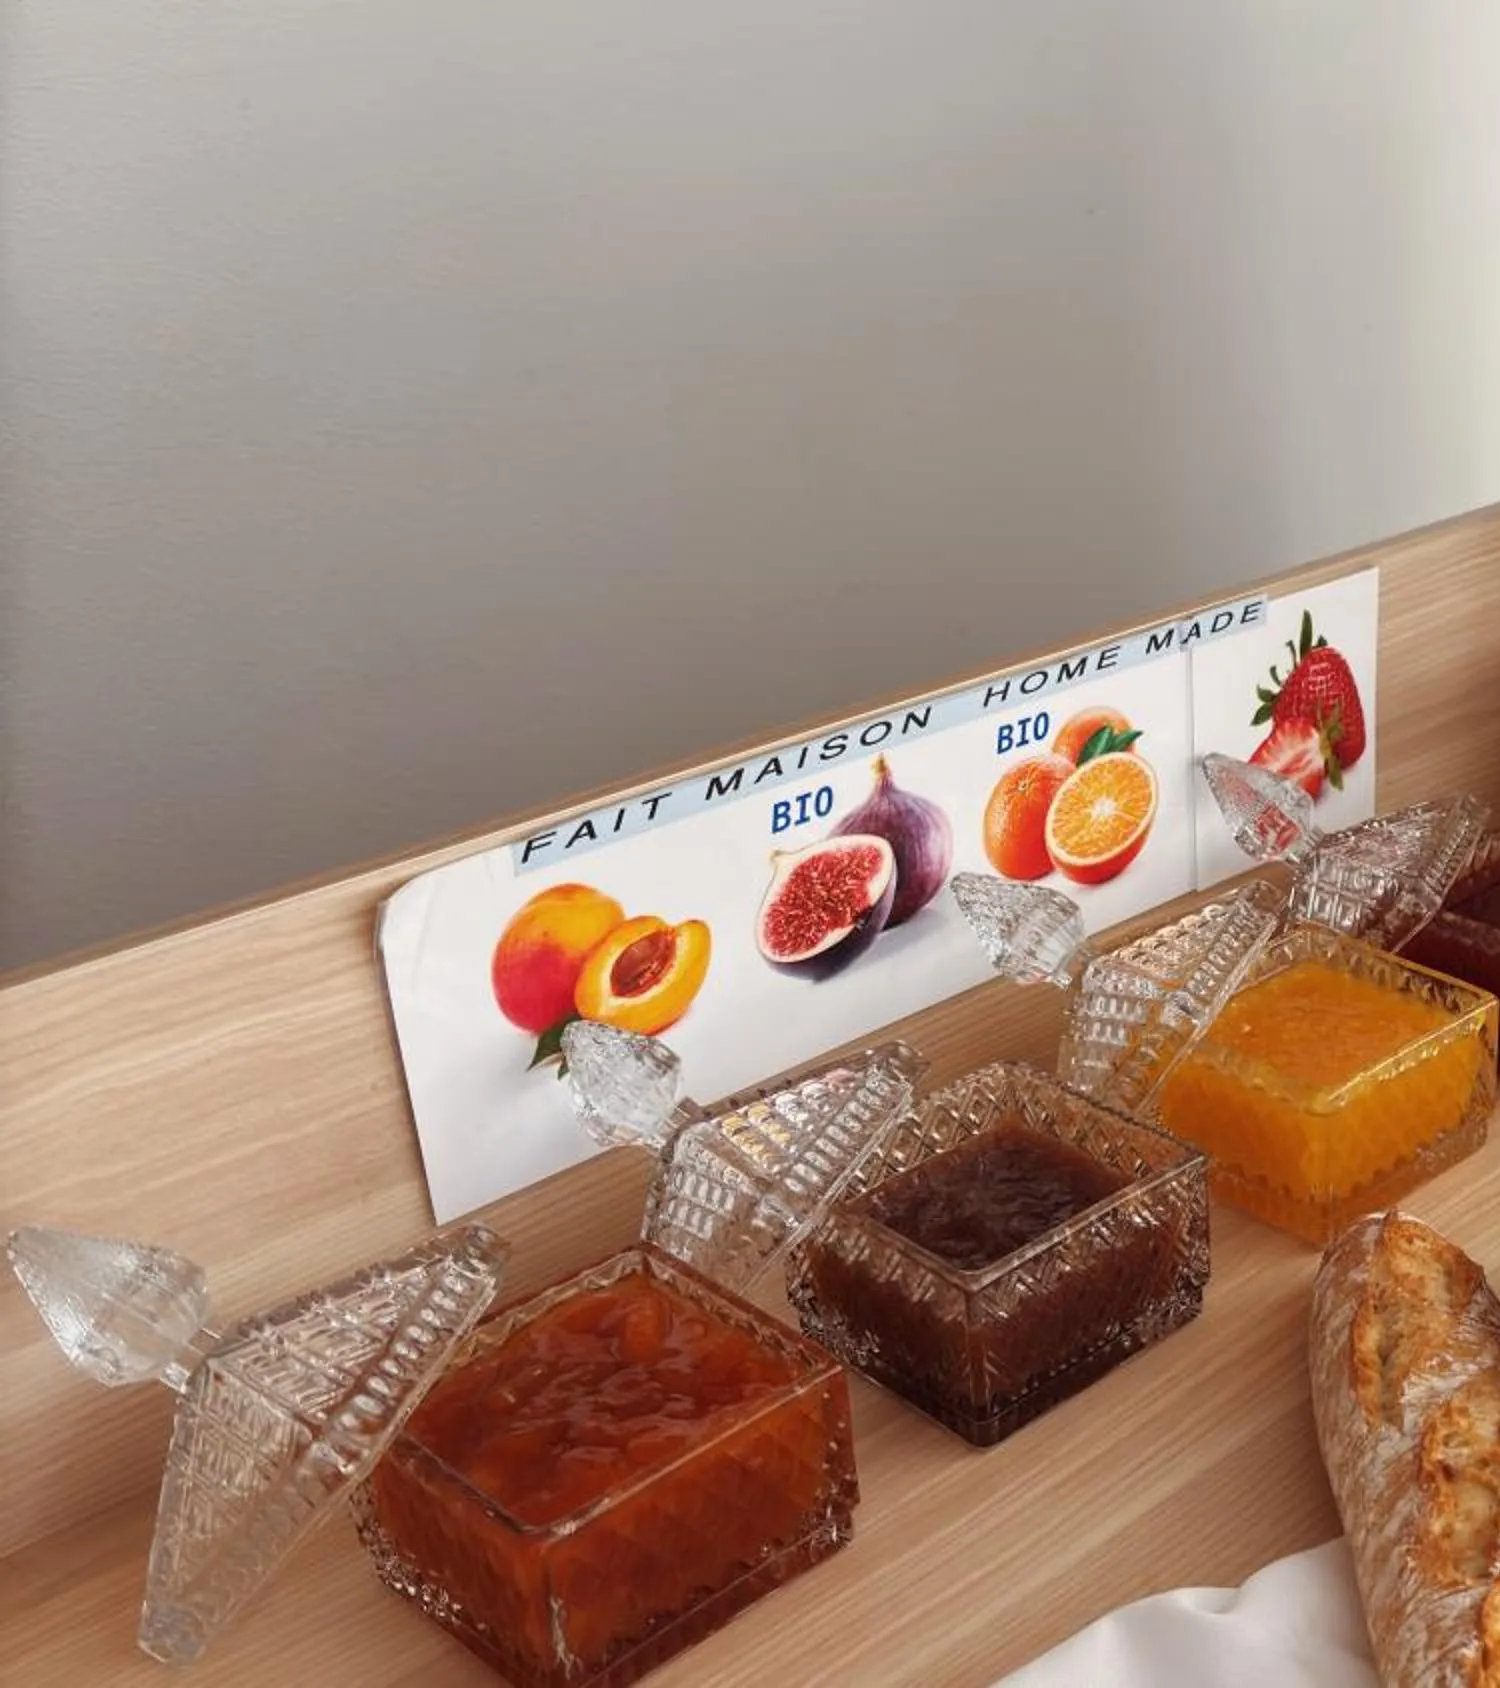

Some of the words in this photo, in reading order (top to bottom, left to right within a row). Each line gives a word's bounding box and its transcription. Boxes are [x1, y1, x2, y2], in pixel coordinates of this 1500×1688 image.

[520, 792, 673, 864] FAIT
[705, 706, 932, 800] MAISON
[983, 646, 1121, 707] HOME
[1144, 601, 1264, 656] MADE
[996, 711, 1050, 754] BIO
[771, 786, 834, 834] BIO
